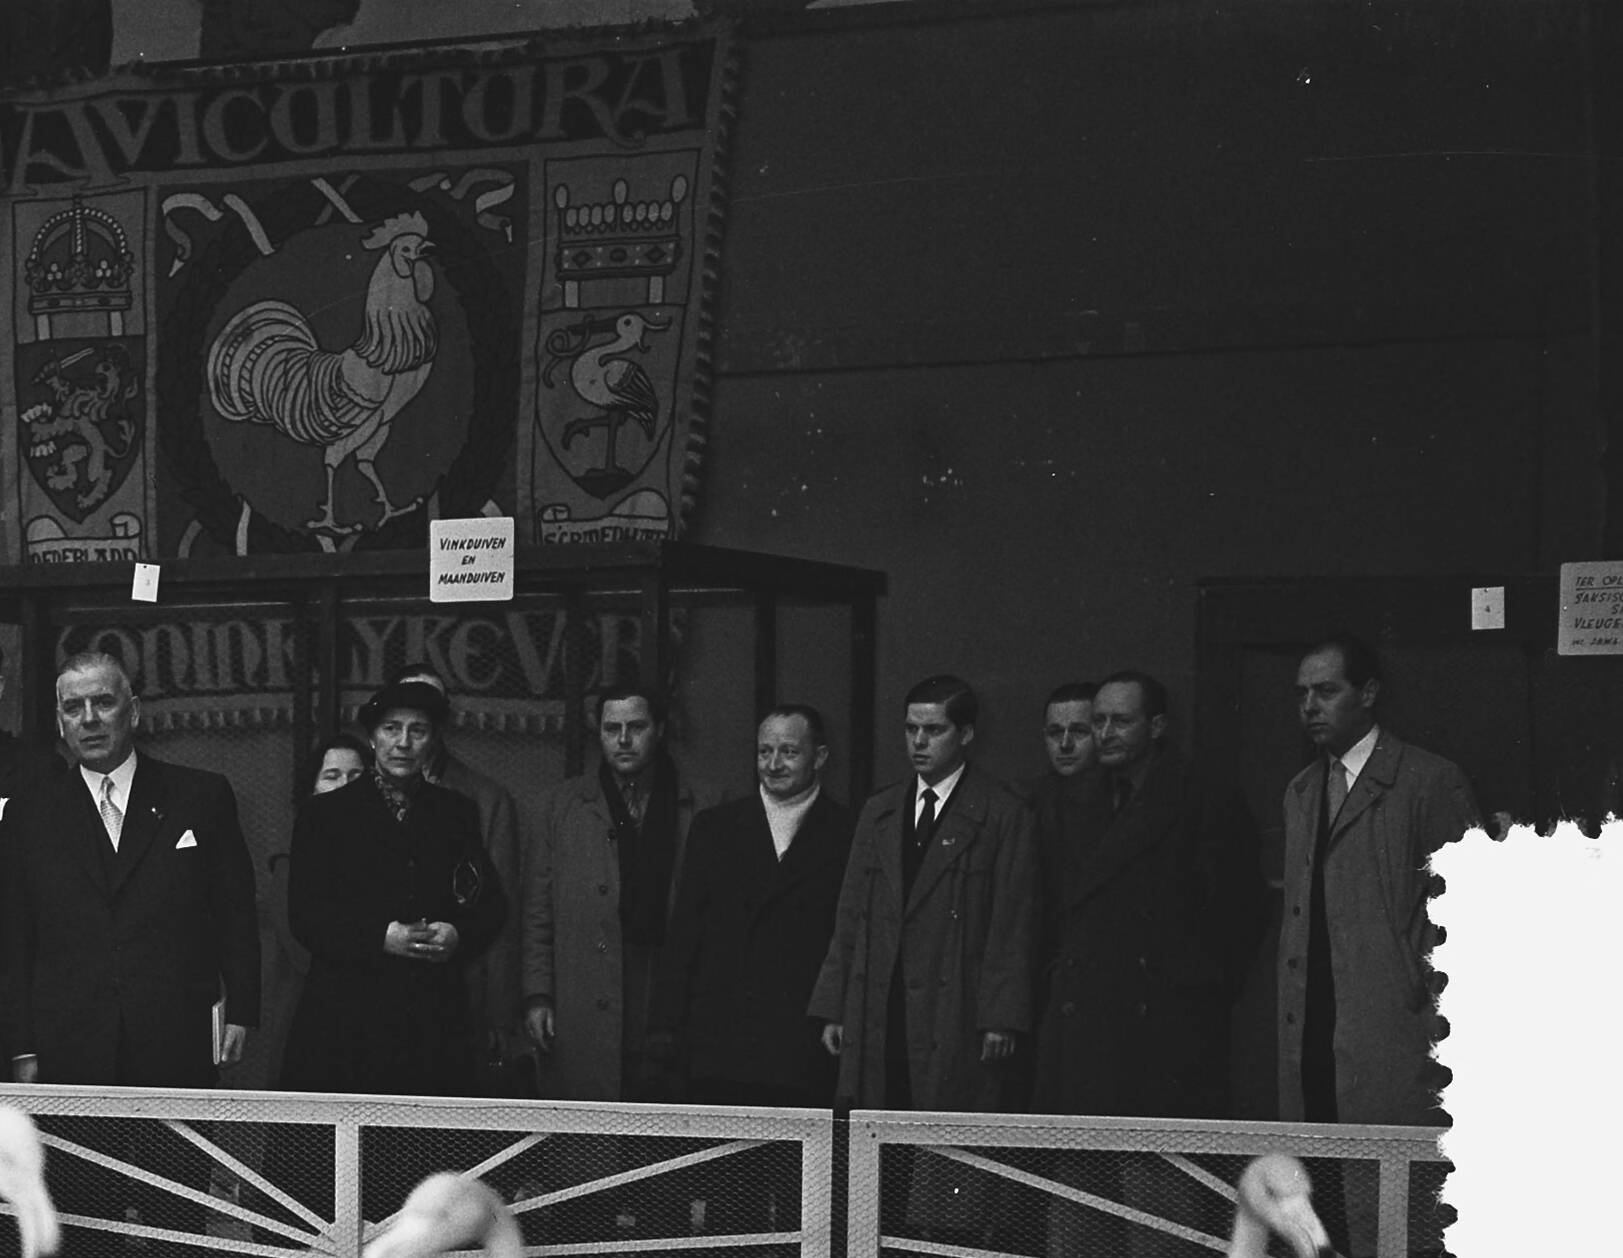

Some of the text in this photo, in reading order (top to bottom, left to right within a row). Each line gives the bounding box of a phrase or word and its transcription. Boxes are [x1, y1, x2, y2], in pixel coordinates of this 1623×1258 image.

[440, 538, 506, 550] VINKDUIVEN
[461, 555, 476, 565] EN
[438, 572, 506, 584] MAANDUIVEN
[1575, 576, 1595, 587] TER
[1574, 617, 1623, 629] VLEUGE
[56, 615, 506, 696] ONINKYKE
